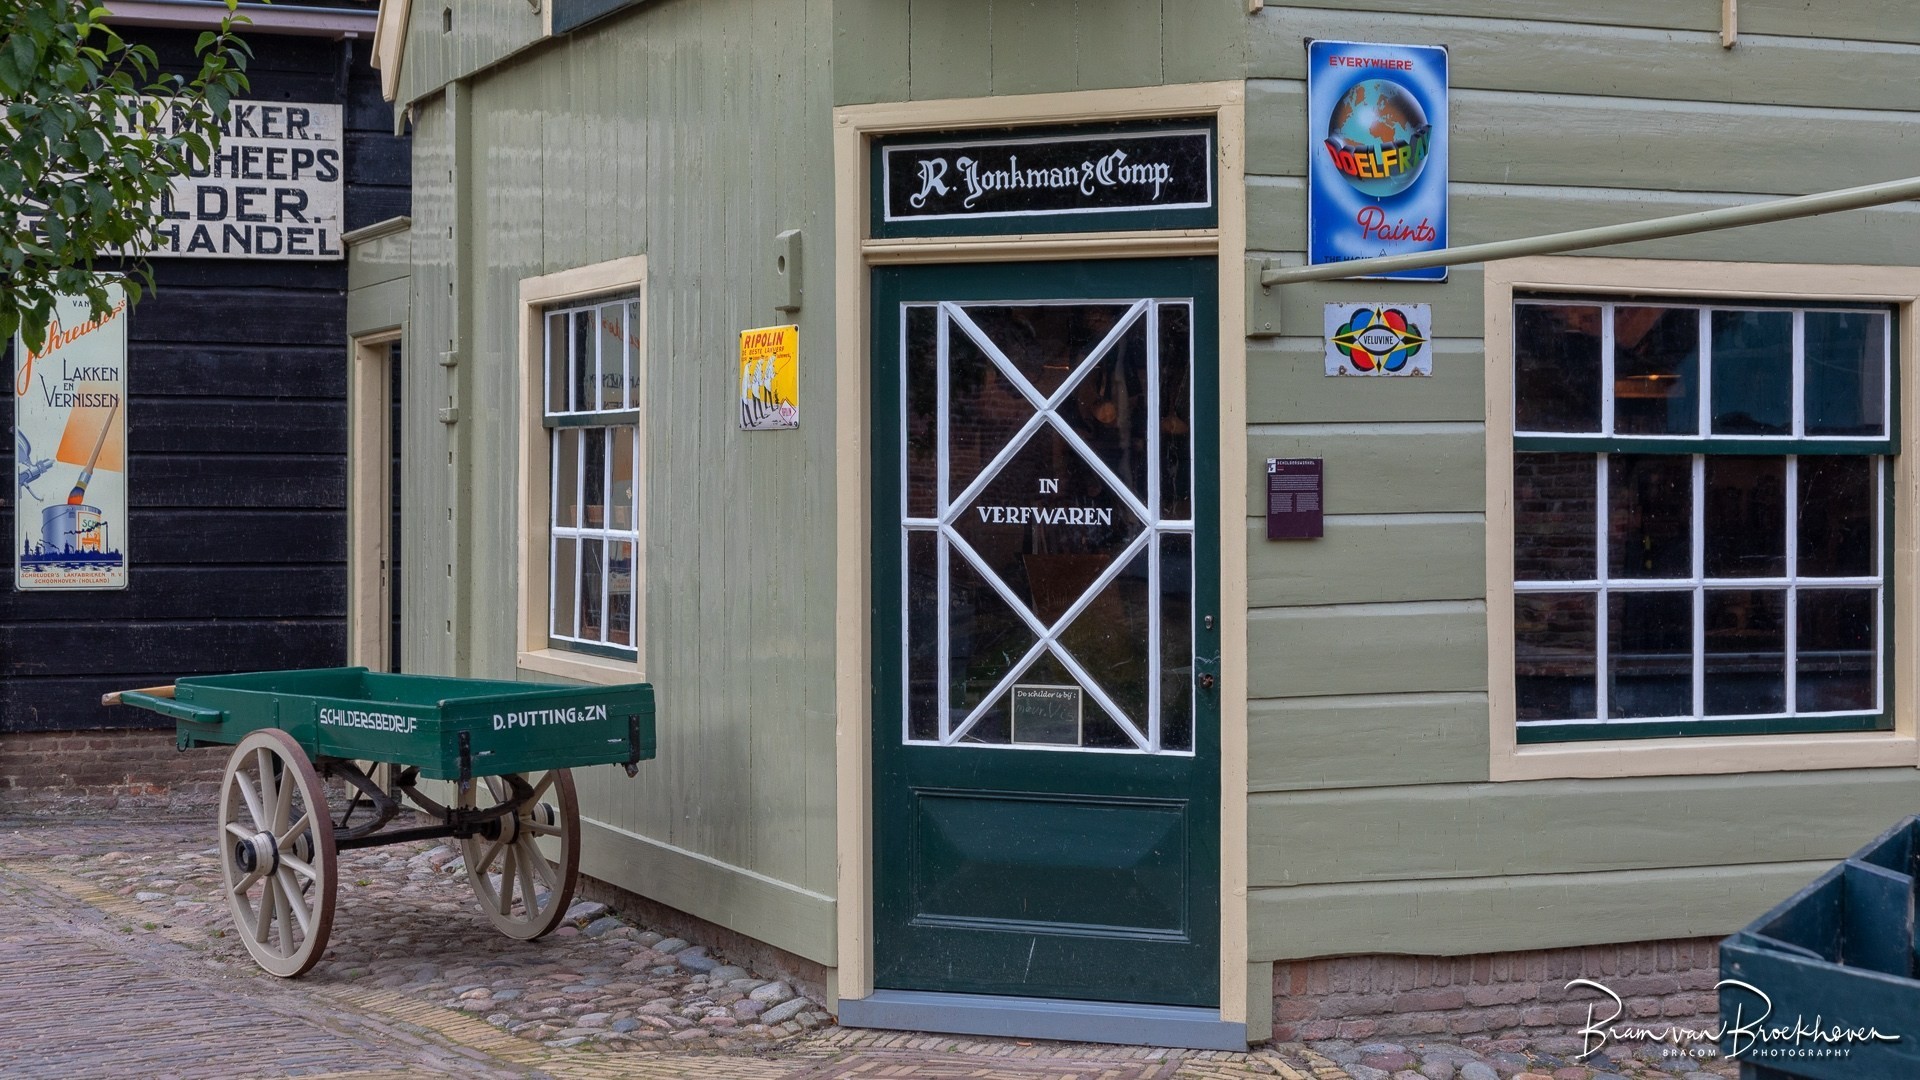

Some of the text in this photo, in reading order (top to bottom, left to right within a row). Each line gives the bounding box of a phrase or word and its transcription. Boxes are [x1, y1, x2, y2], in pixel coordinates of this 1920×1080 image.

[1329, 56, 1412, 70] EVERYWHERE
[909, 157, 957, 208] R.
[1357, 205, 1436, 242] Paints
[72, 300, 90, 308] VAN
[744, 331, 784, 349] RIPOLIN
[1363, 335, 1394, 345] VELUVINE
[63, 358, 119, 382] LAKKEN
[38, 372, 119, 407] VERNISSEN
[63, 382, 74, 391] EN
[1038, 478, 1059, 494] IN
[976, 506, 1113, 526] VERFWAREN
